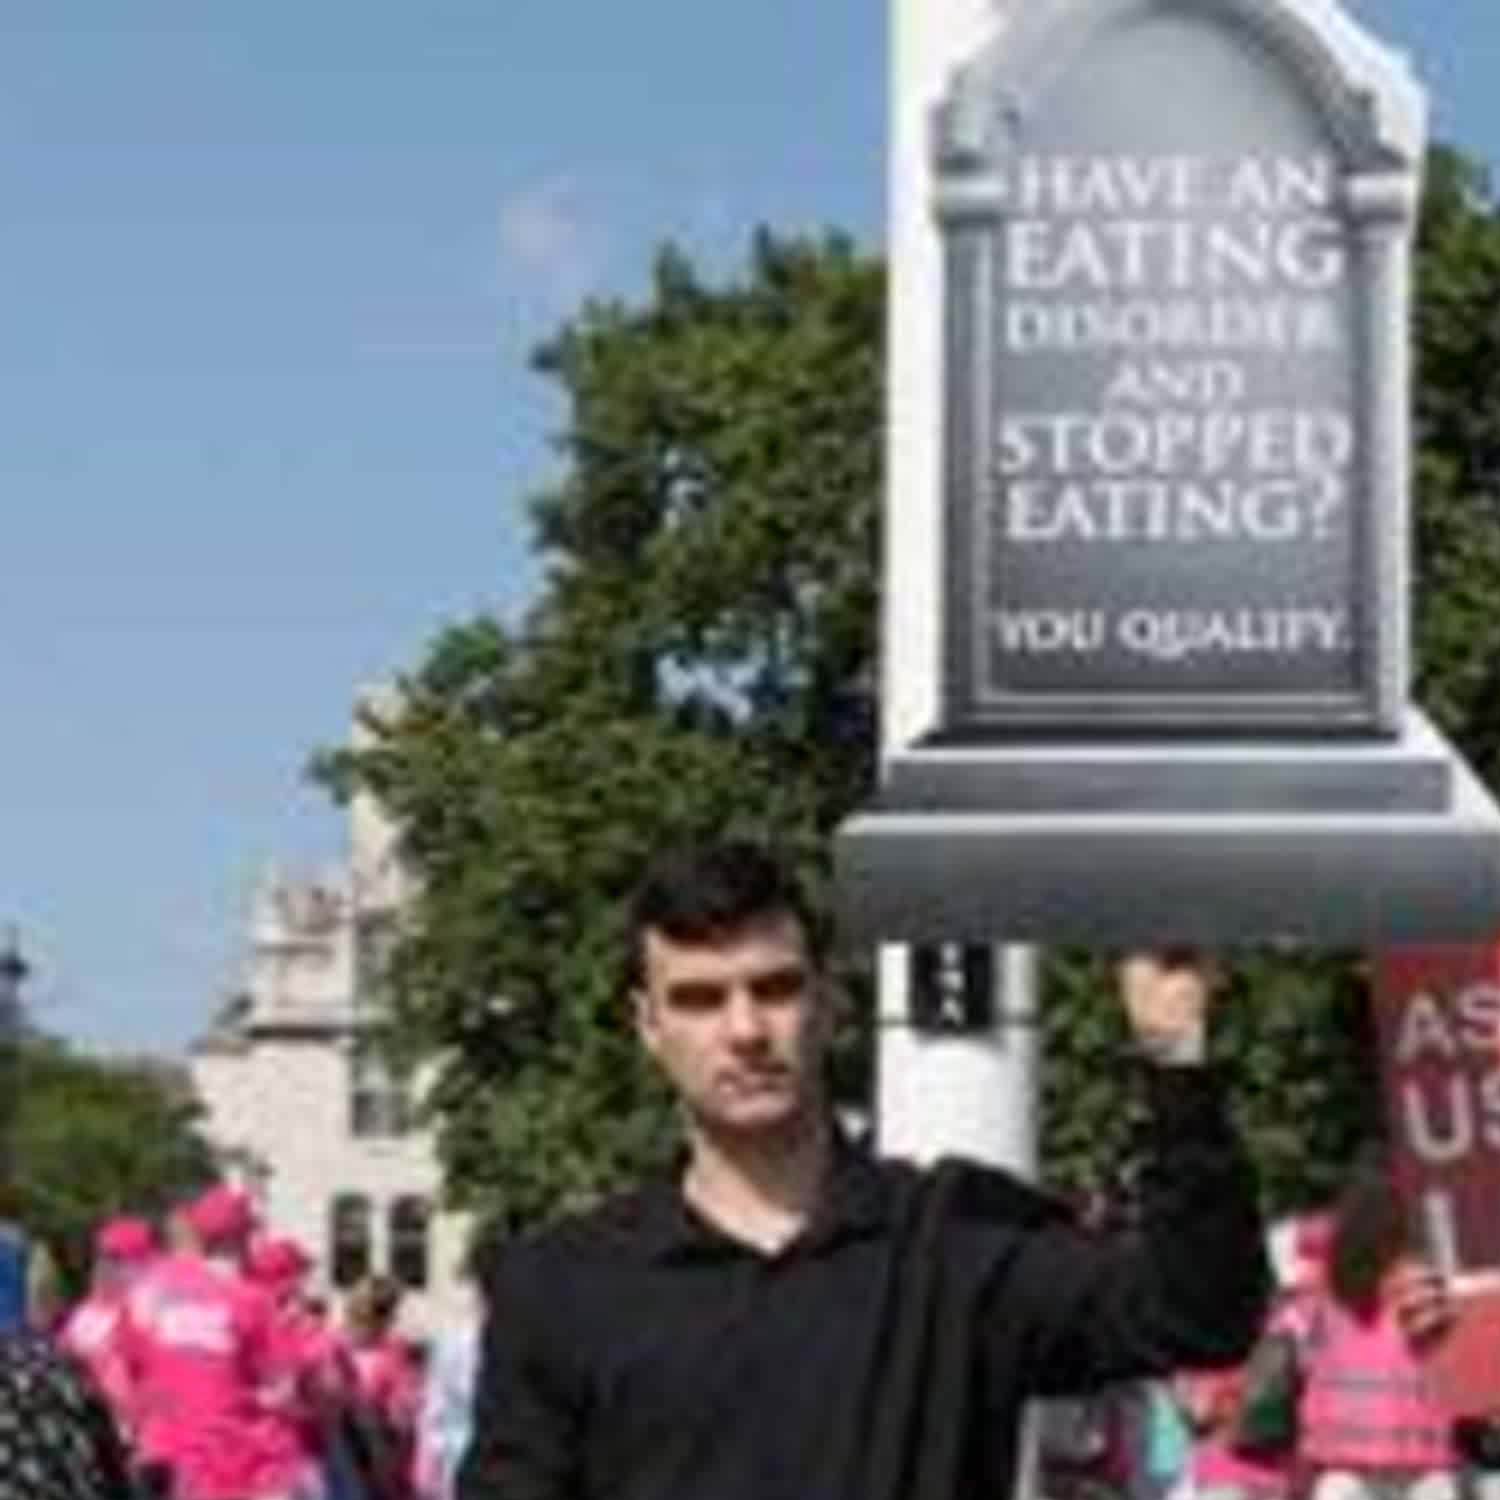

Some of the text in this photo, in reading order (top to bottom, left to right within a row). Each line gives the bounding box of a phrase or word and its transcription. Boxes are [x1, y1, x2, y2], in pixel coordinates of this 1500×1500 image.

[1022, 155, 1333, 209] HAVE AN
[1008, 220, 1342, 288] EATING
[1008, 300, 1338, 351] DISORDER
[1106, 360, 1244, 400] AND
[998, 410, 1352, 473] STOPPED
[1008, 478, 1341, 540] EATING?
[998, 608, 1102, 651] YOU
